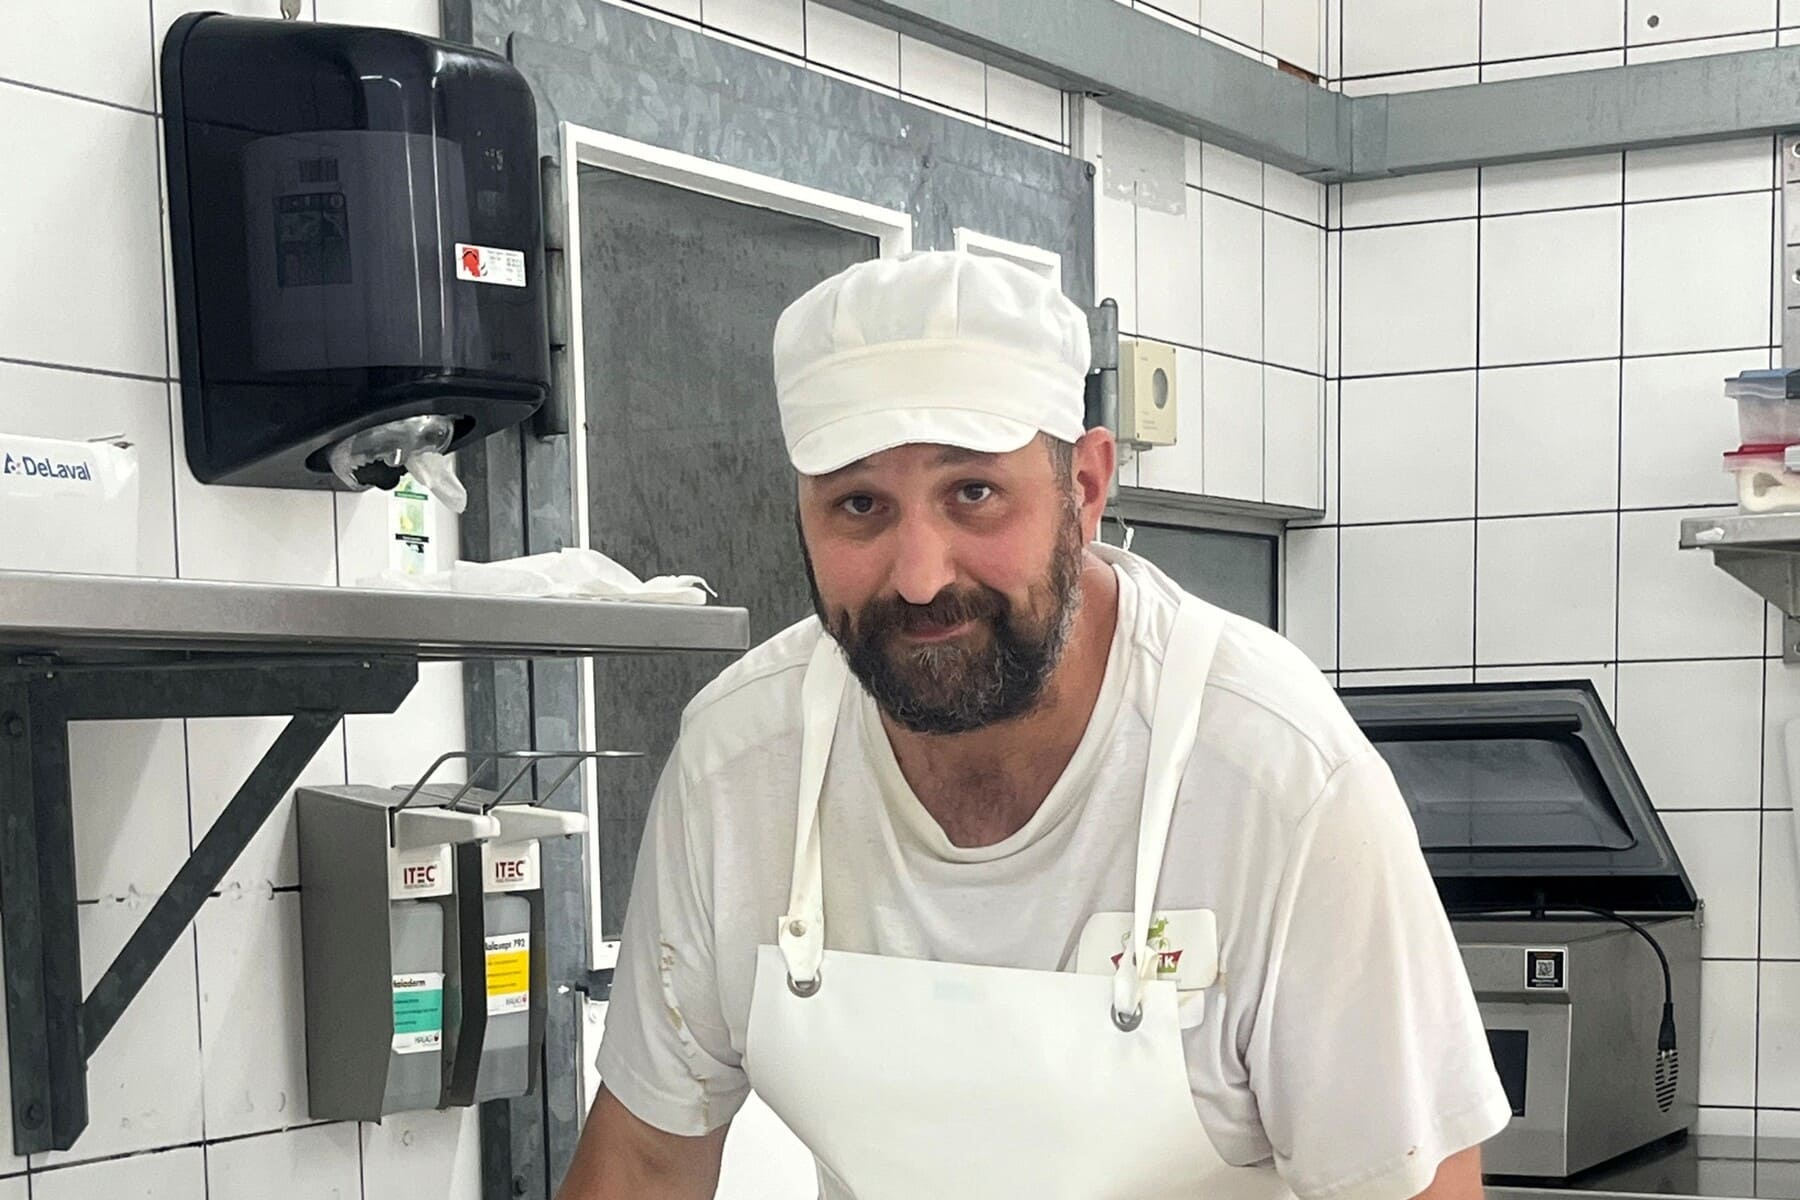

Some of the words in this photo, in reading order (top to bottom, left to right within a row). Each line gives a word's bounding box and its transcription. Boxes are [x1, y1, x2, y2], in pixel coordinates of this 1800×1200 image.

[22, 456, 91, 480] DeLaval
[403, 865, 436, 885] ITEC
[495, 860, 525, 879] ITEC
[513, 938, 525, 948] 792
